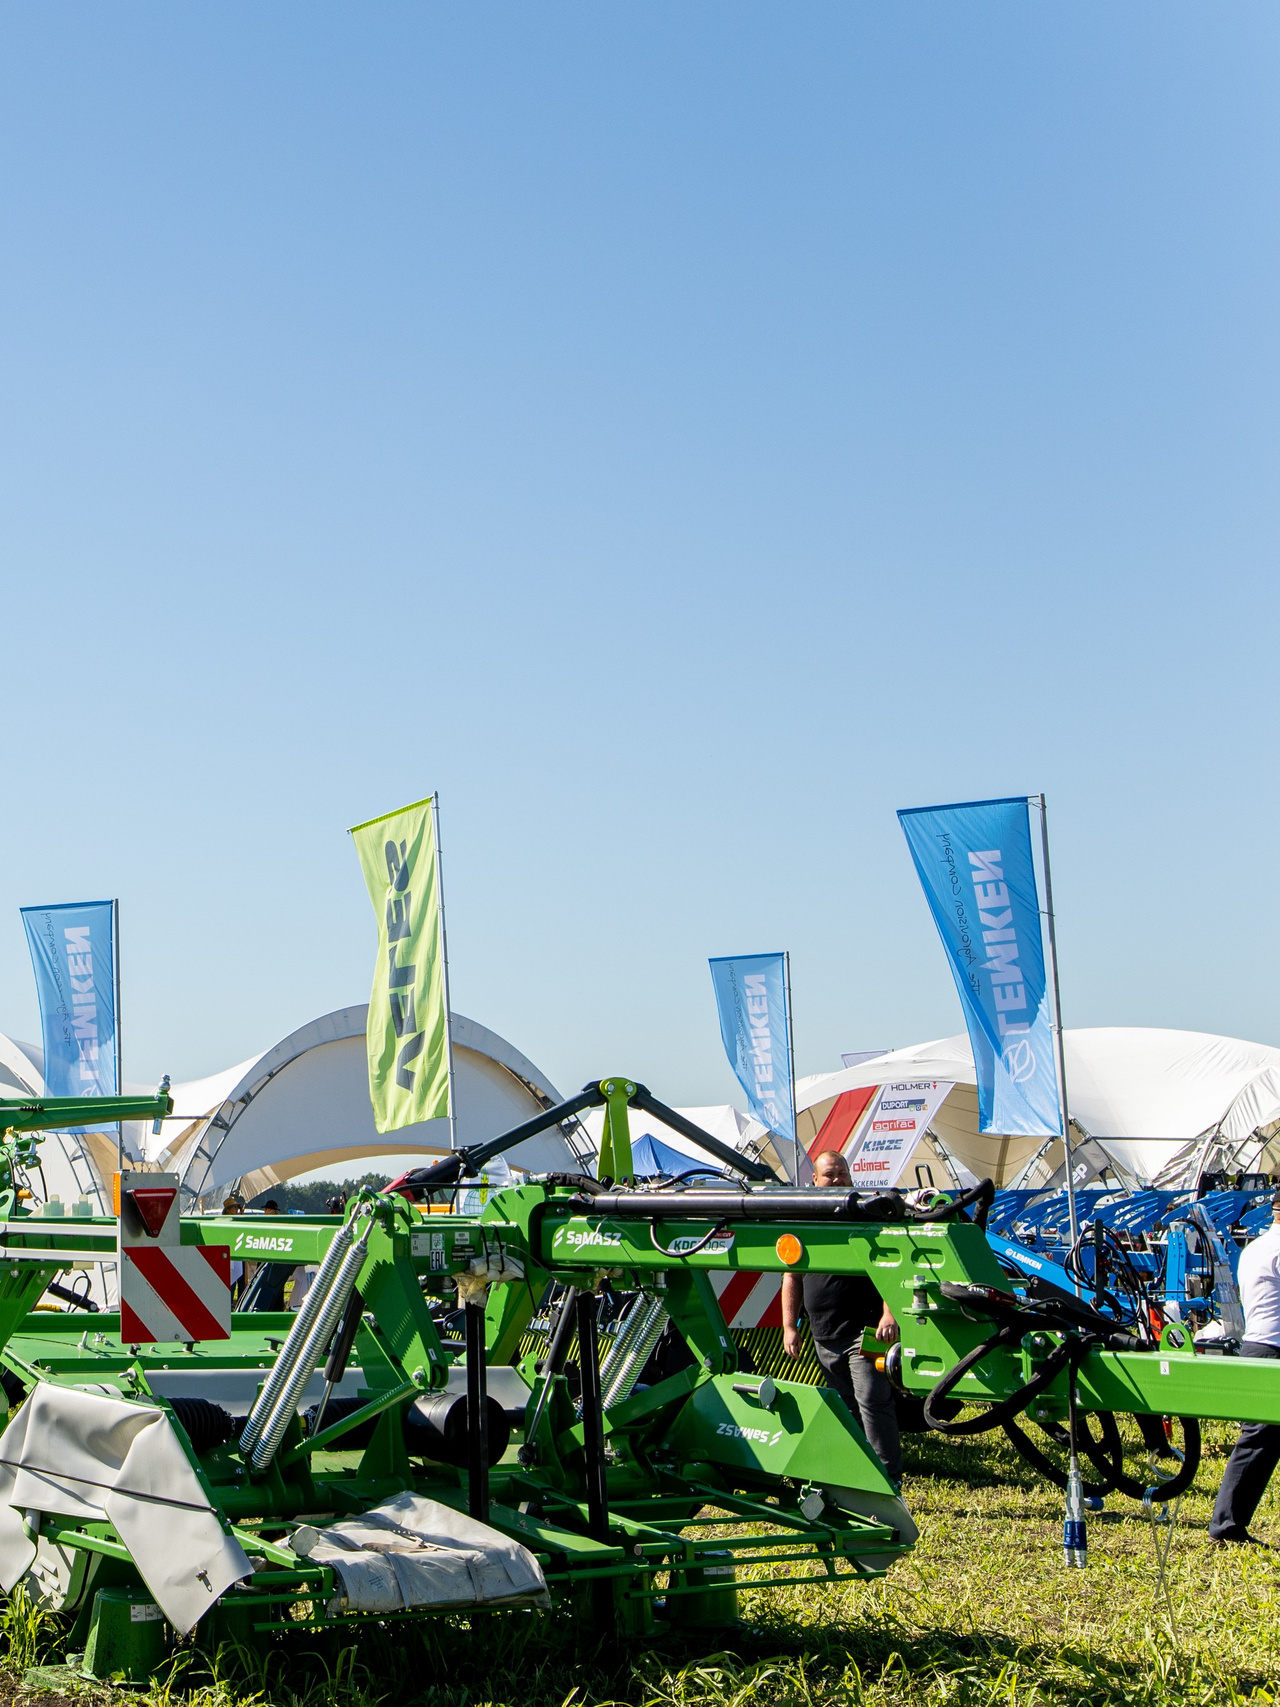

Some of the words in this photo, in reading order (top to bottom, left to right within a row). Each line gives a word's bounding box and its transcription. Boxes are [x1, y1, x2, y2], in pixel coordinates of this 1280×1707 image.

[891, 1083, 931, 1091] HOLMER
[882, 1101, 908, 1110] DUPORT
[874, 1119, 913, 1131] agrifac
[862, 1139, 903, 1152] KINZE
[245, 1235, 294, 1252] SaMASZ
[566, 1230, 622, 1247] SaMASZ
[1012, 1251, 1043, 1270] LEMKEN
[716, 1423, 770, 1443] SaMASZ
